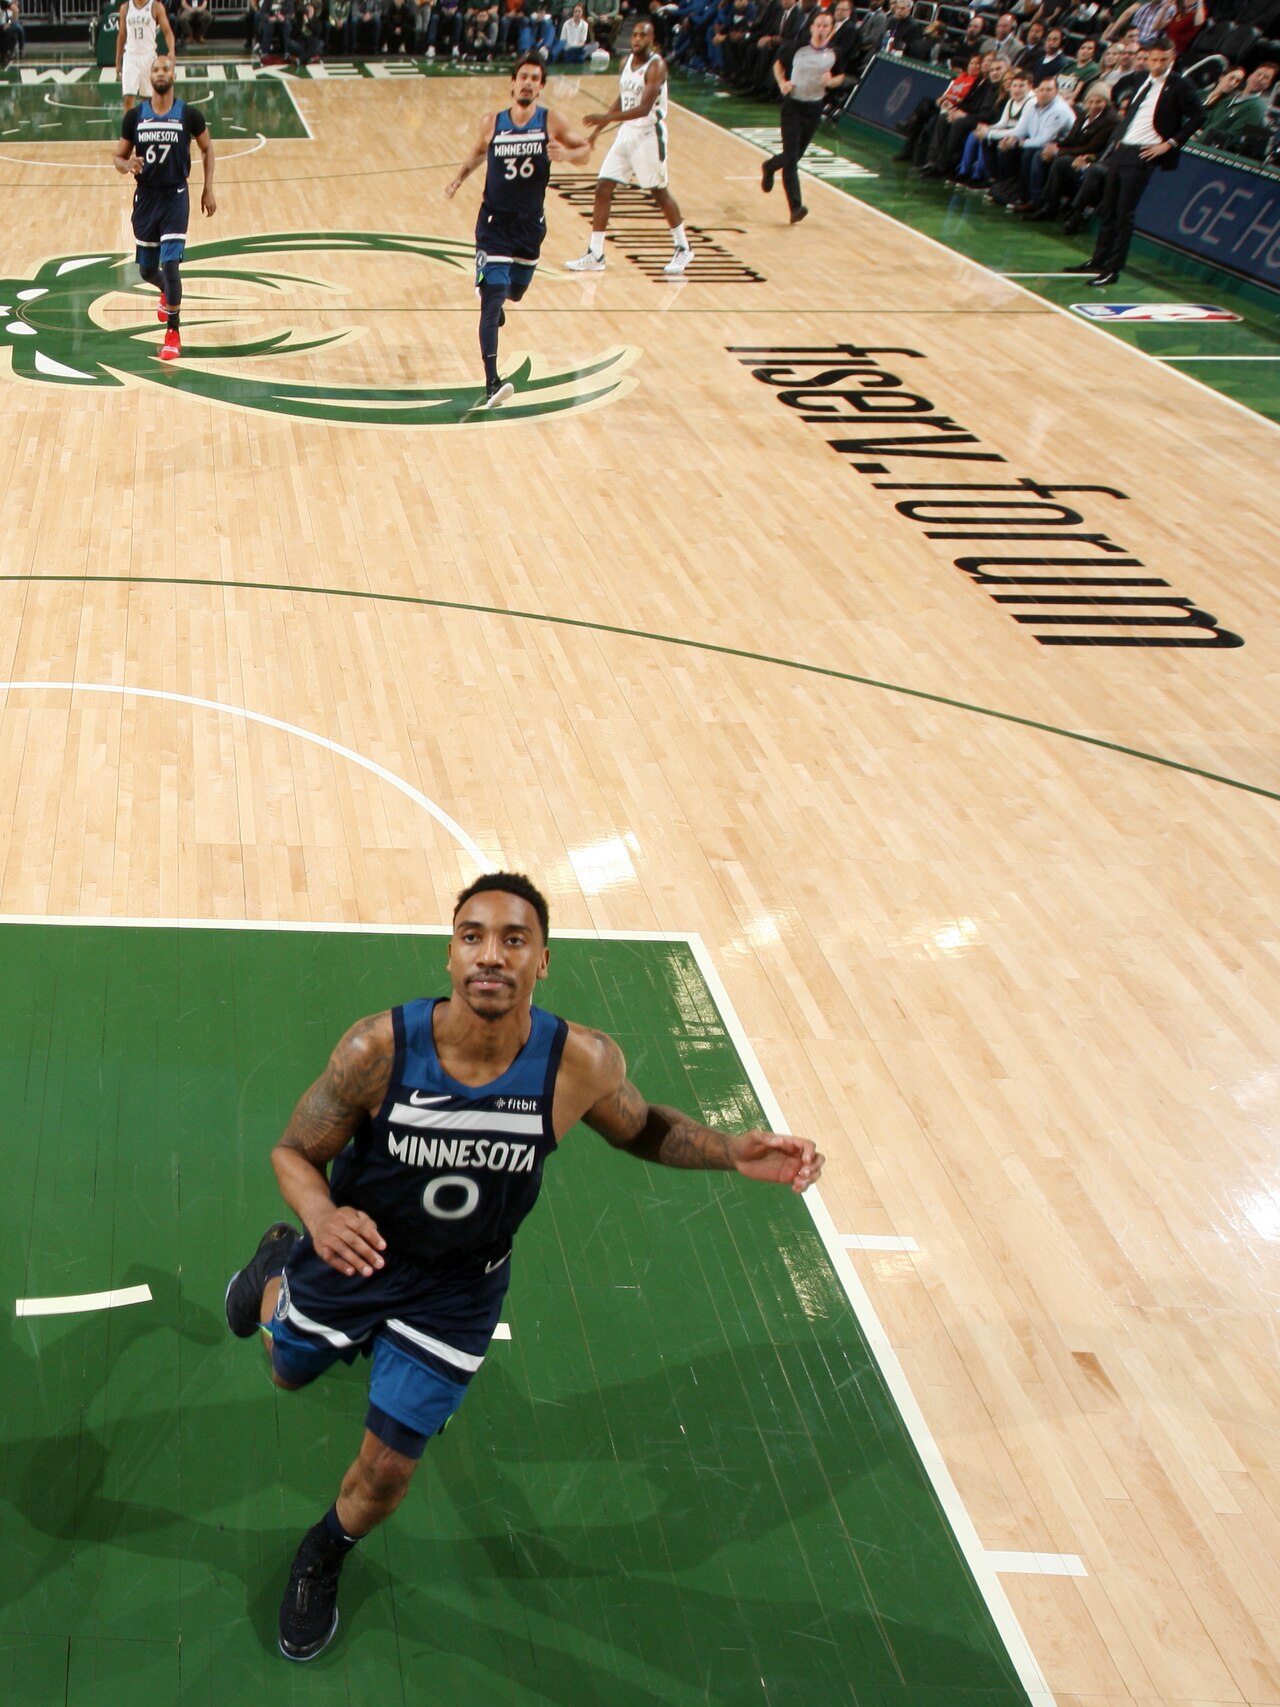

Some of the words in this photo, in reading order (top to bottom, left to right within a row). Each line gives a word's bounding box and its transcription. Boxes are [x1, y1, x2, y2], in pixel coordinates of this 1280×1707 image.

[134, 27, 144, 40] 13
[138, 131, 179, 142] MINNESOTA
[145, 144, 172, 164] 67
[494, 142, 543, 157] MINNESOTA
[503, 157, 535, 180] 36
[1178, 180, 1254, 245] GE
[507, 1098, 537, 1111] fitbit
[388, 1131, 536, 1172] MINNESOTA
[423, 1175, 480, 1220] 0
